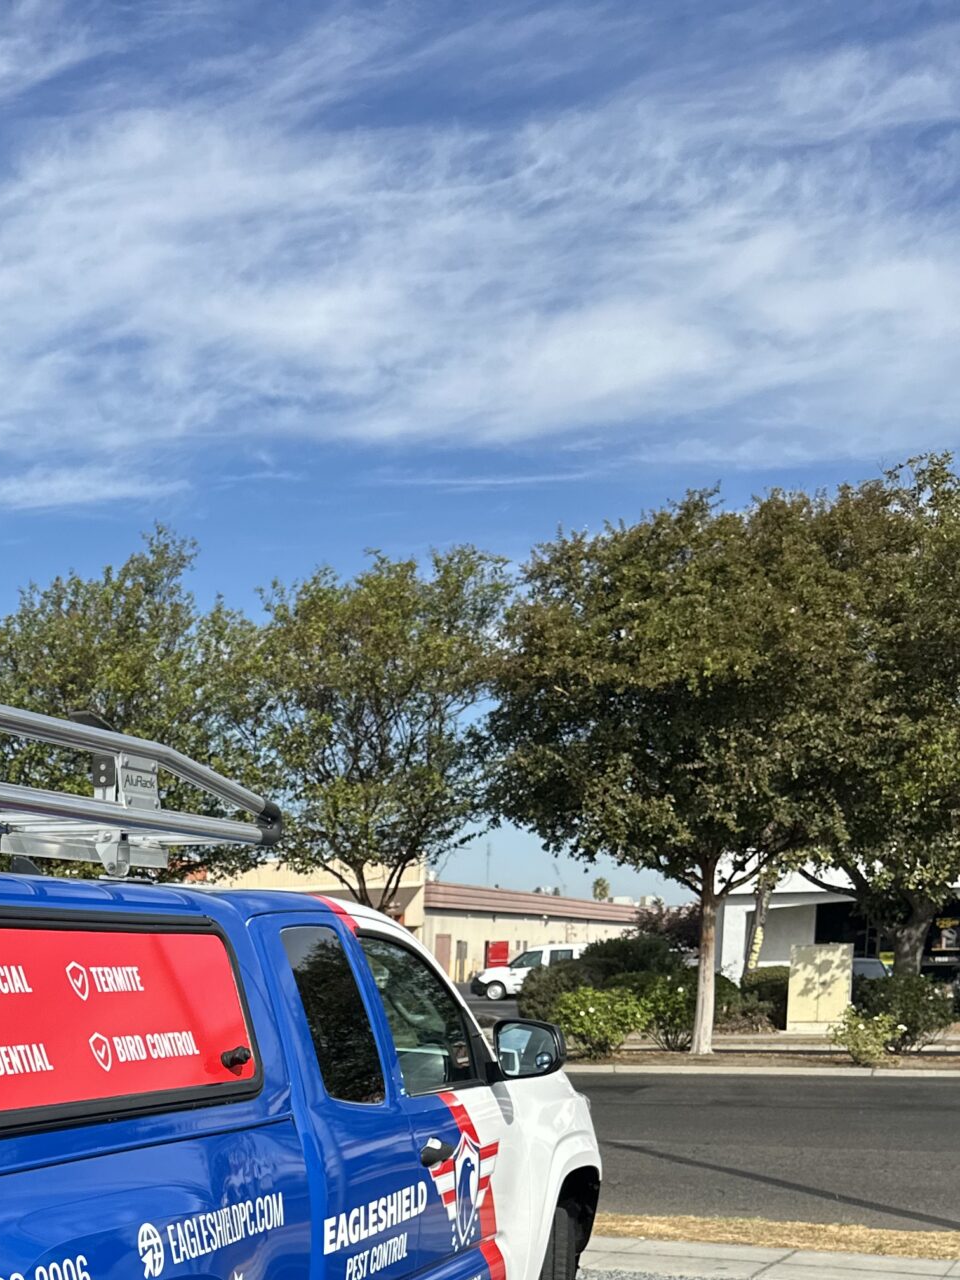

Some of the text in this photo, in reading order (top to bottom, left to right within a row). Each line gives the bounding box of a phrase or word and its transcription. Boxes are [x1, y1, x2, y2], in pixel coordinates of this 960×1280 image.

[124, 774, 155, 788] AluRack
[89, 965, 145, 993] TERMITE
[114, 1030, 200, 1063] BIRD CONTROL
[167, 1191, 284, 1265] EAGLESHIELDPC.COM
[323, 1180, 428, 1255] EAGLESHIELD
[369, 1232, 408, 1275] CONTROL
